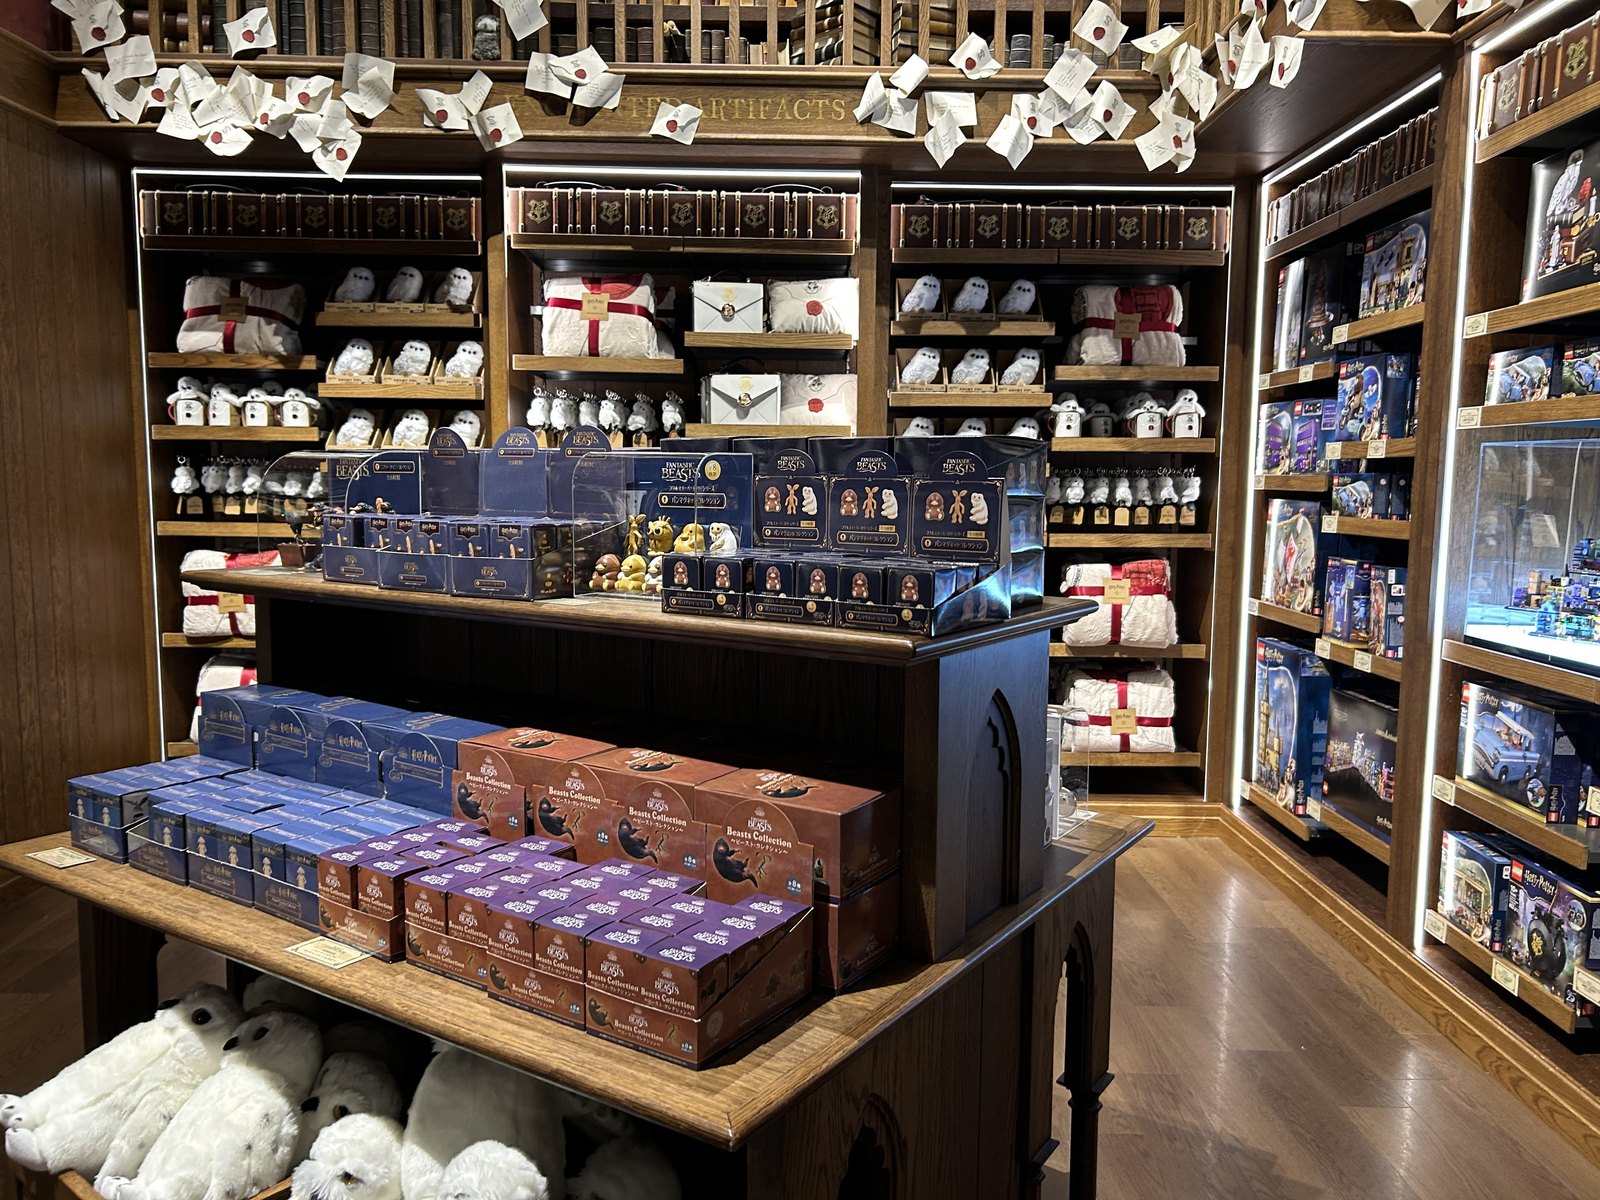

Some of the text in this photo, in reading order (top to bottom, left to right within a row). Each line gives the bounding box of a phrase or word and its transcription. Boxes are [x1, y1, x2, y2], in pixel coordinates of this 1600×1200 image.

[699, 97, 846, 121] ARTIFACTS
[661, 467, 701, 482] BEASTS
[777, 460, 805, 471] BEASTS
[856, 461, 887, 473] BEASTS
[942, 463, 976, 475] BEASTS
[466, 772, 511, 790] Beasts Collection
[549, 786, 601, 804] Beasts Collection
[629, 806, 687, 826] Beasts Collection
[726, 826, 792, 848] Beasts Collection
[1524, 870, 1555, 896] Harry Potter
[535, 953, 582, 975] Beasts Collection
[588, 970, 639, 992] Beasts Collection
[641, 987, 695, 1011] Beasts Collection
[614, 1020, 664, 1042] Beasts Collection
